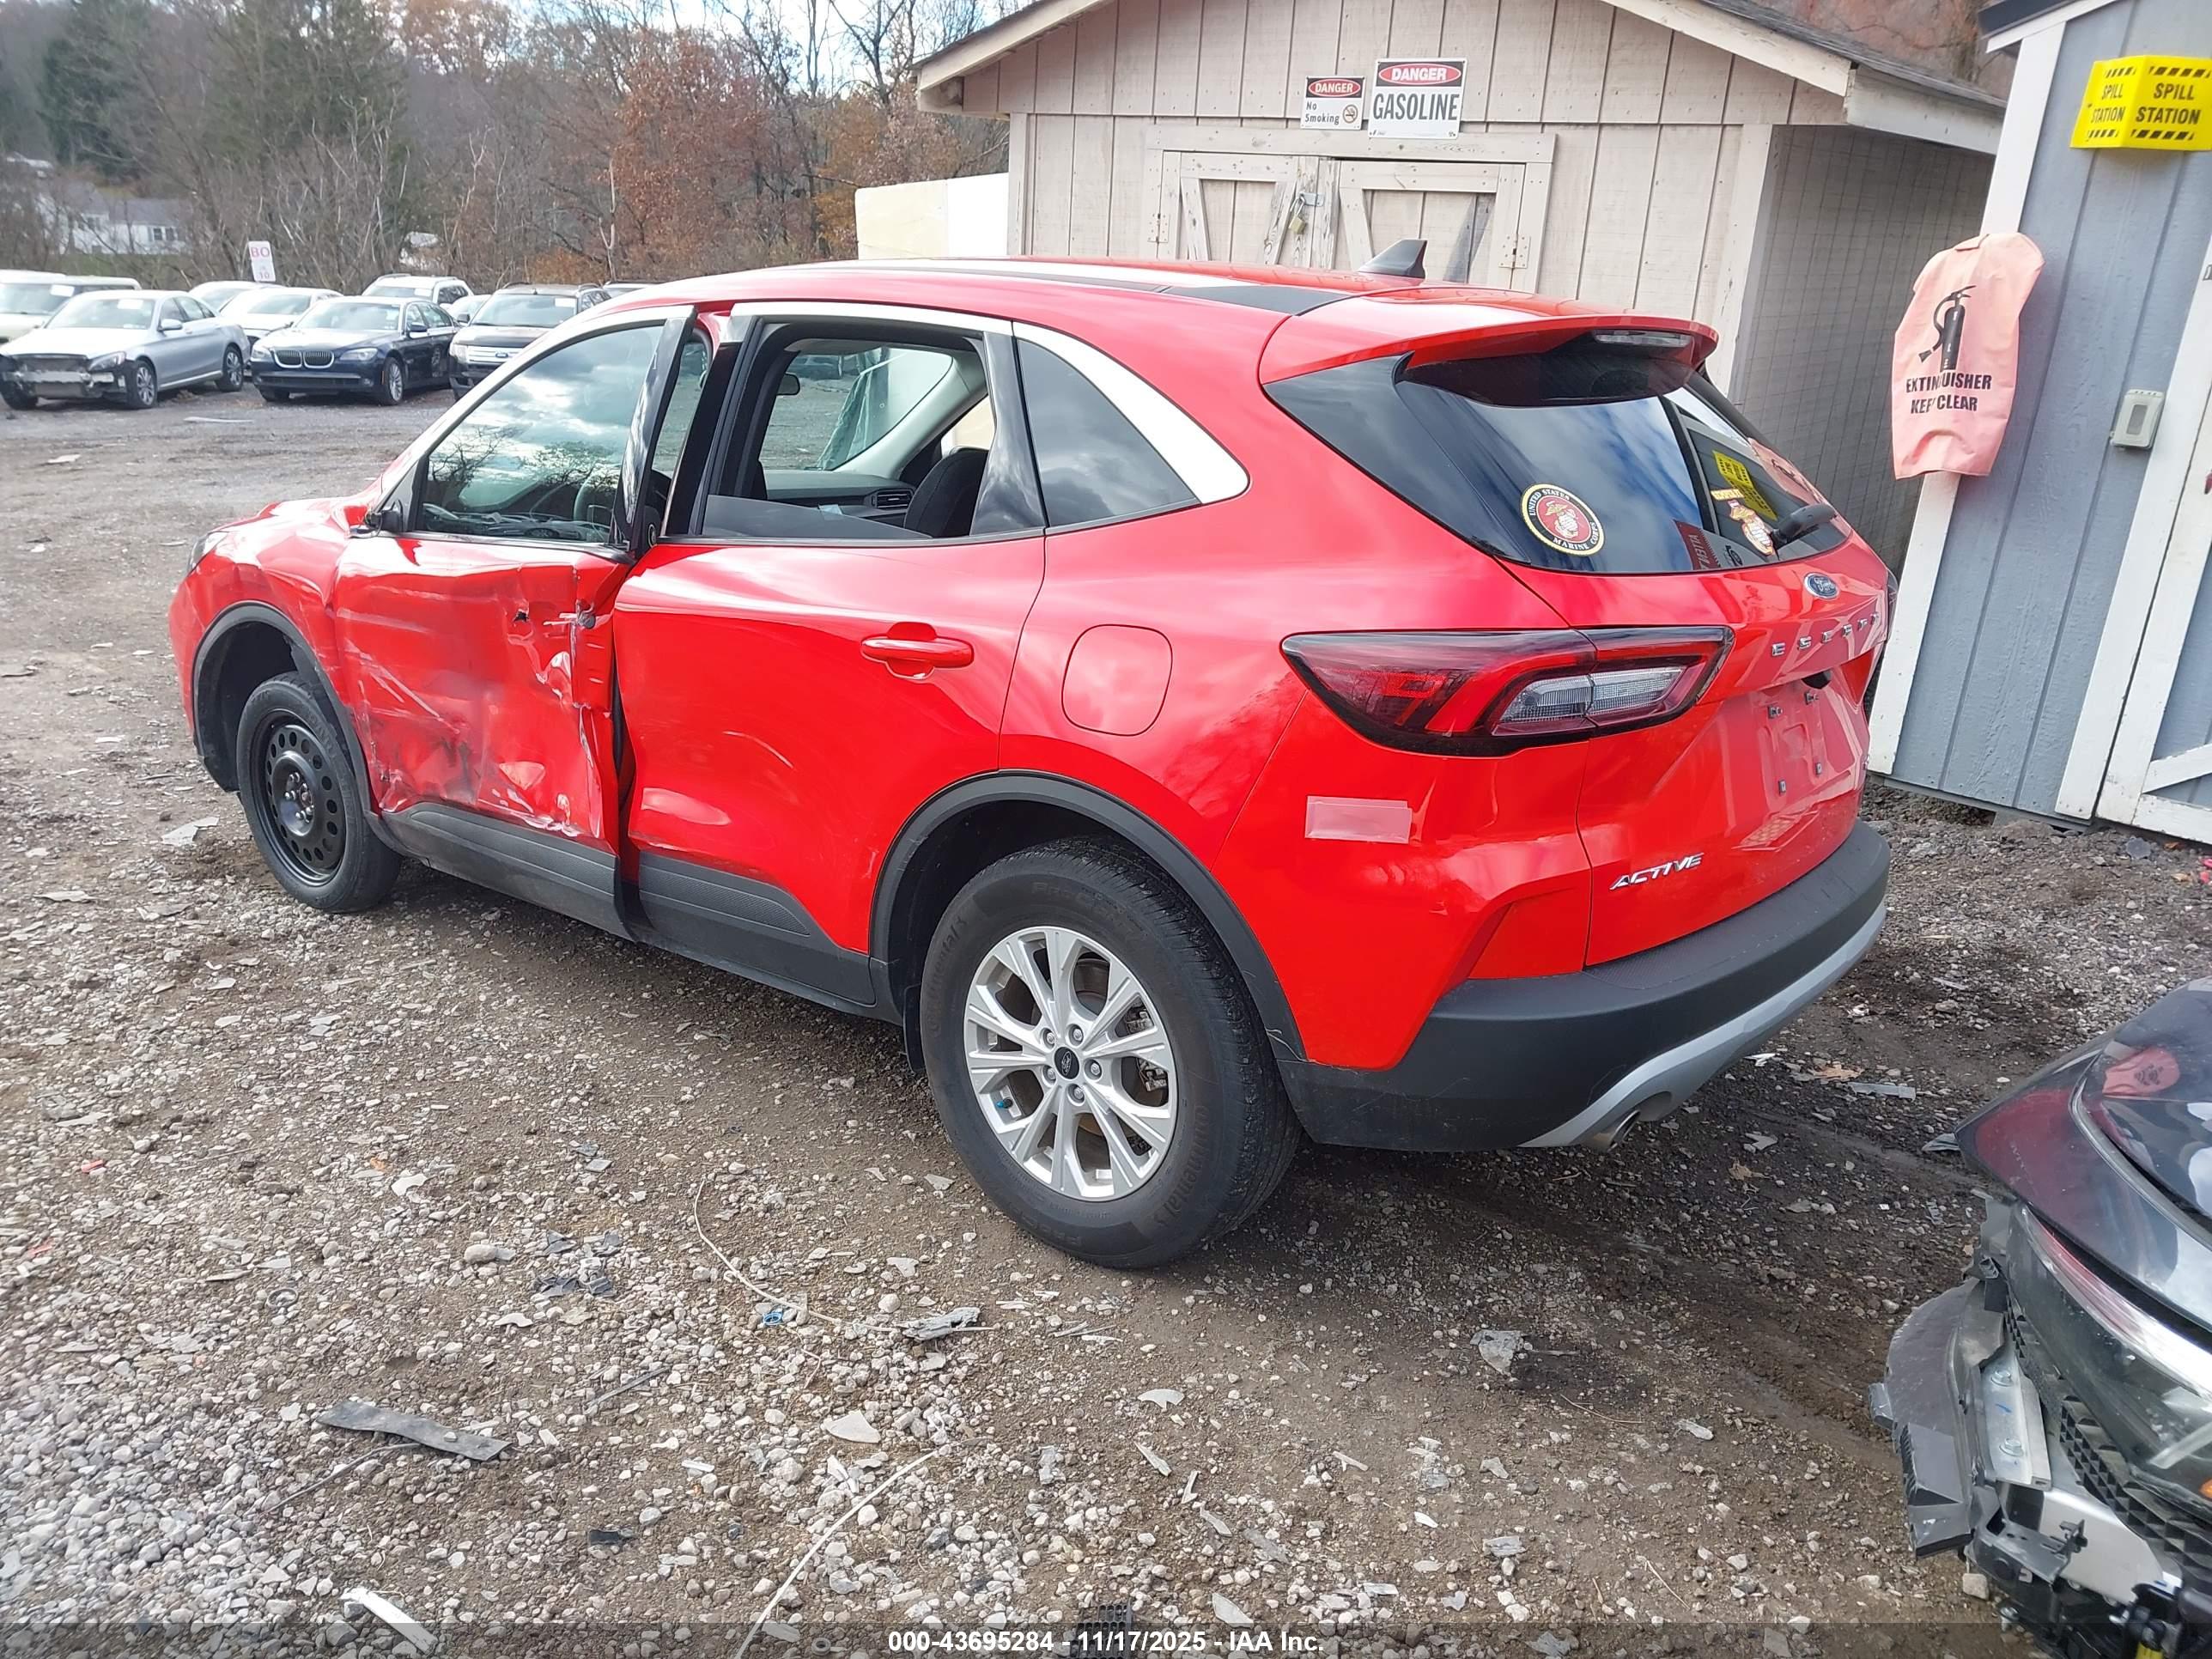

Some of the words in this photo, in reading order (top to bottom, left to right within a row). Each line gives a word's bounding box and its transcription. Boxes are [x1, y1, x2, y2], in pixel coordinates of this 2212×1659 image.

[1391, 68, 1447, 81] DANGER
[1315, 82, 1353, 94] DANGER
[2101, 84, 2124, 100] SPILL
[2153, 82, 2195, 100] SPILL
[1306, 101, 1317, 111] No
[1373, 93, 1460, 120] GASOLINE
[2090, 106, 2126, 124] STATION
[1304, 113, 1340, 125] Smoking
[2135, 106, 2202, 125] STATION
[1936, 394, 1978, 411] CLEAR
[1528, 491, 1542, 516] UNITED
[1541, 489, 1570, 501] STATES
[1553, 537, 1589, 550] MARINE
[1589, 521, 1599, 544] CORPS
[1609, 852, 1705, 890] ACTIVE
